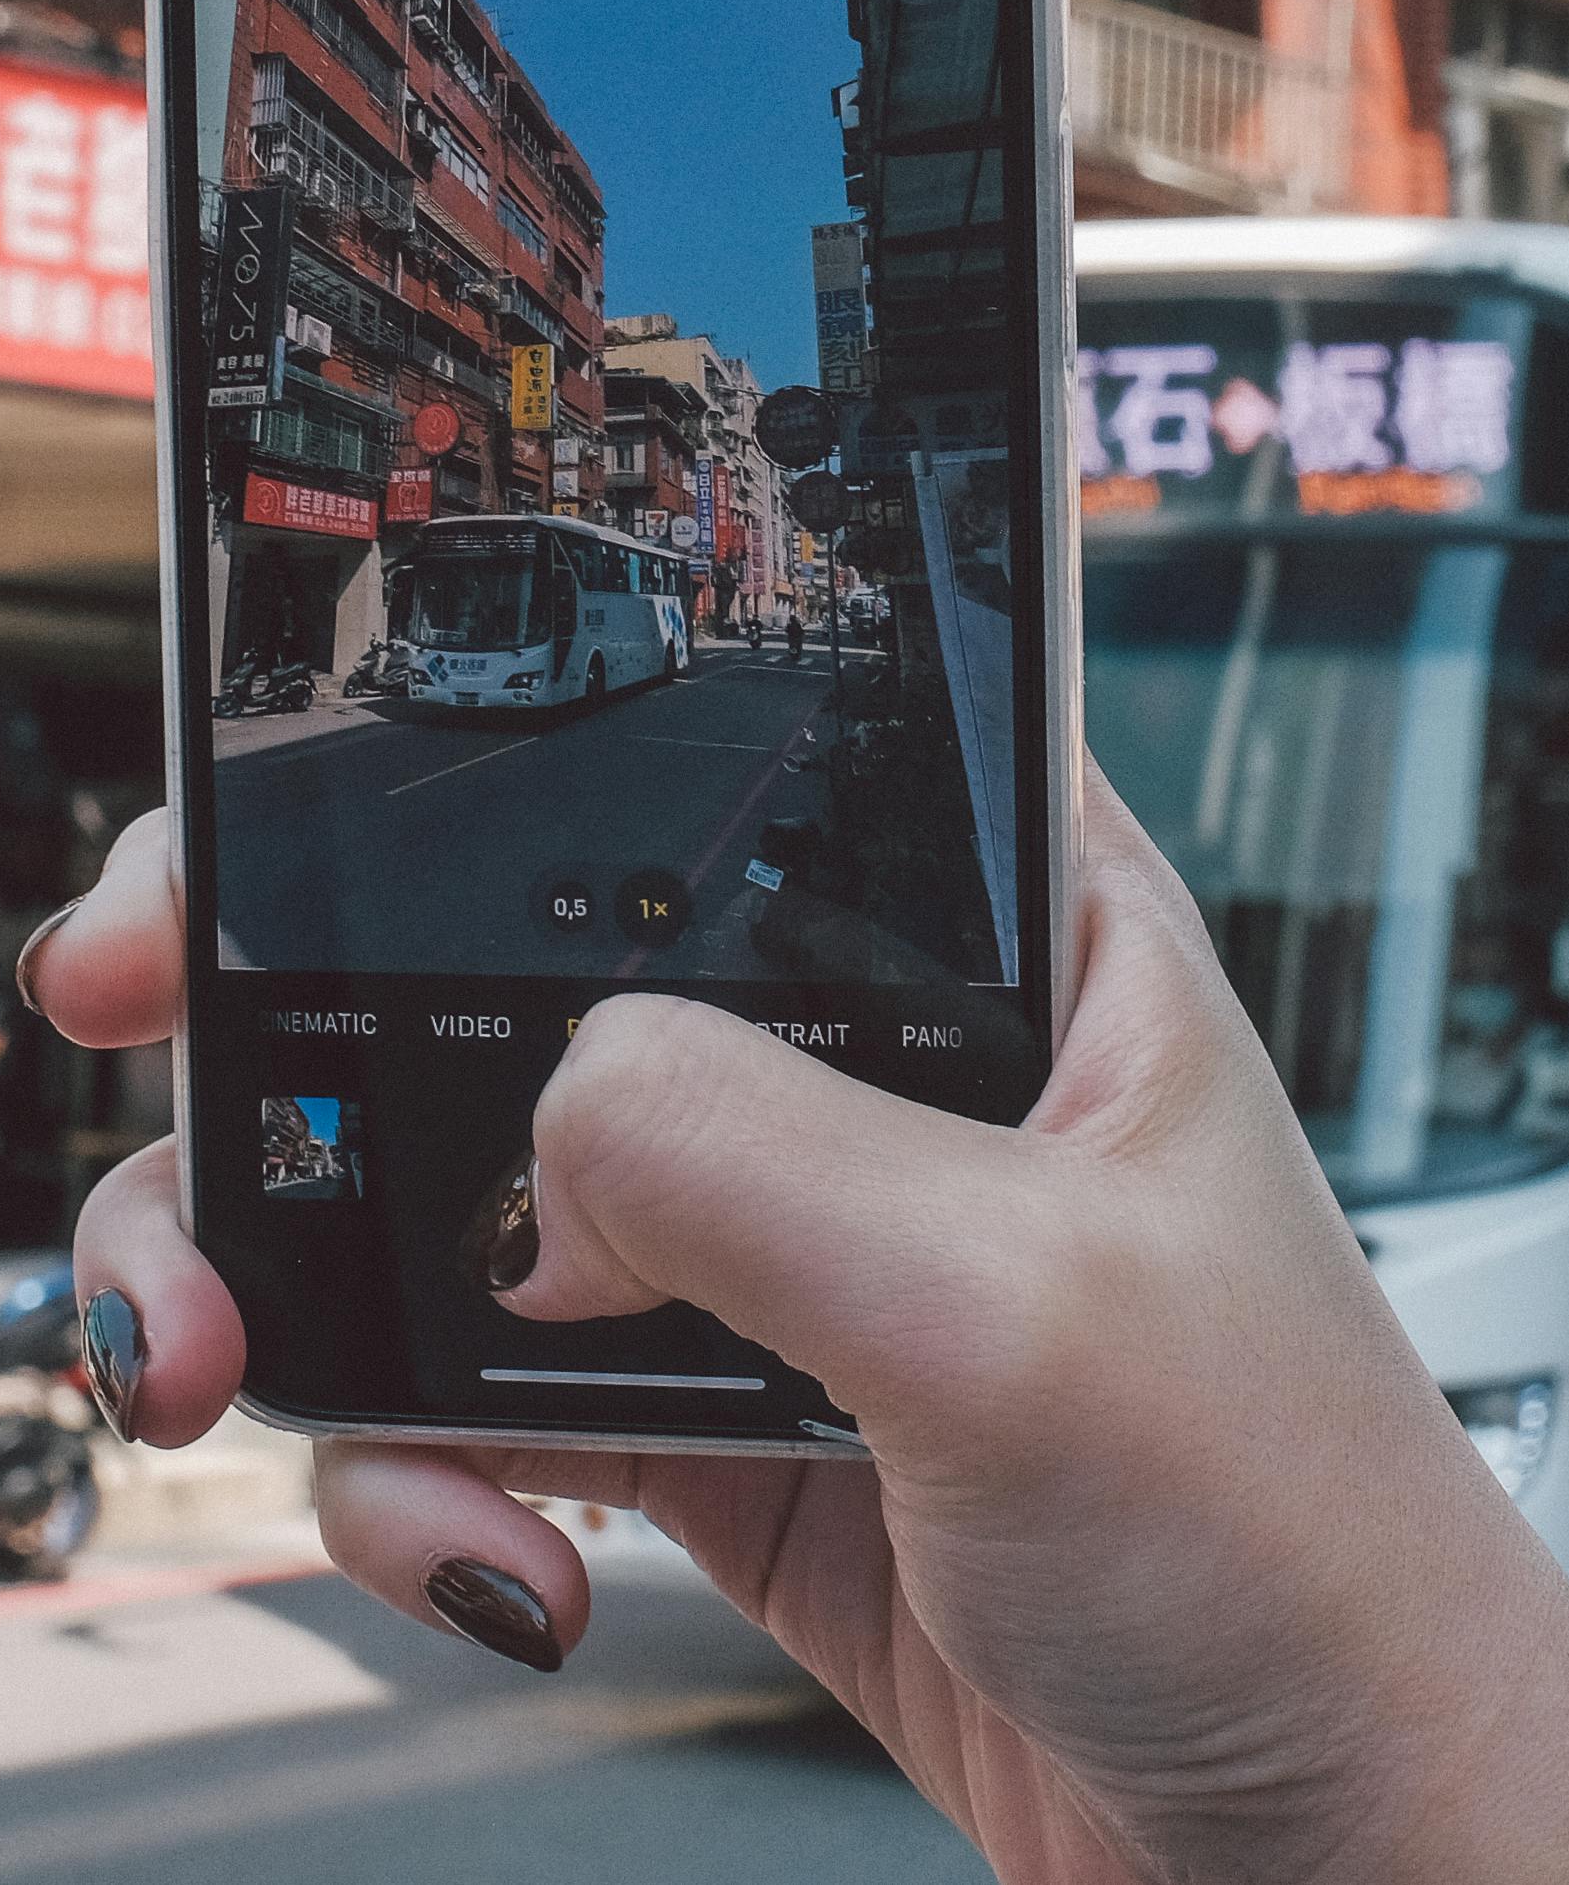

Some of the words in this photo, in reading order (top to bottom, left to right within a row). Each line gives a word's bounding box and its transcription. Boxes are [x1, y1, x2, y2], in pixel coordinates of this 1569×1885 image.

[1076, 341, 1218, 480] 石
[1278, 337, 1514, 478] 板橋
[554, 898, 587, 920] 0,5
[431, 1015, 512, 1039] VIDEO
[902, 1026, 962, 1048] PANO
